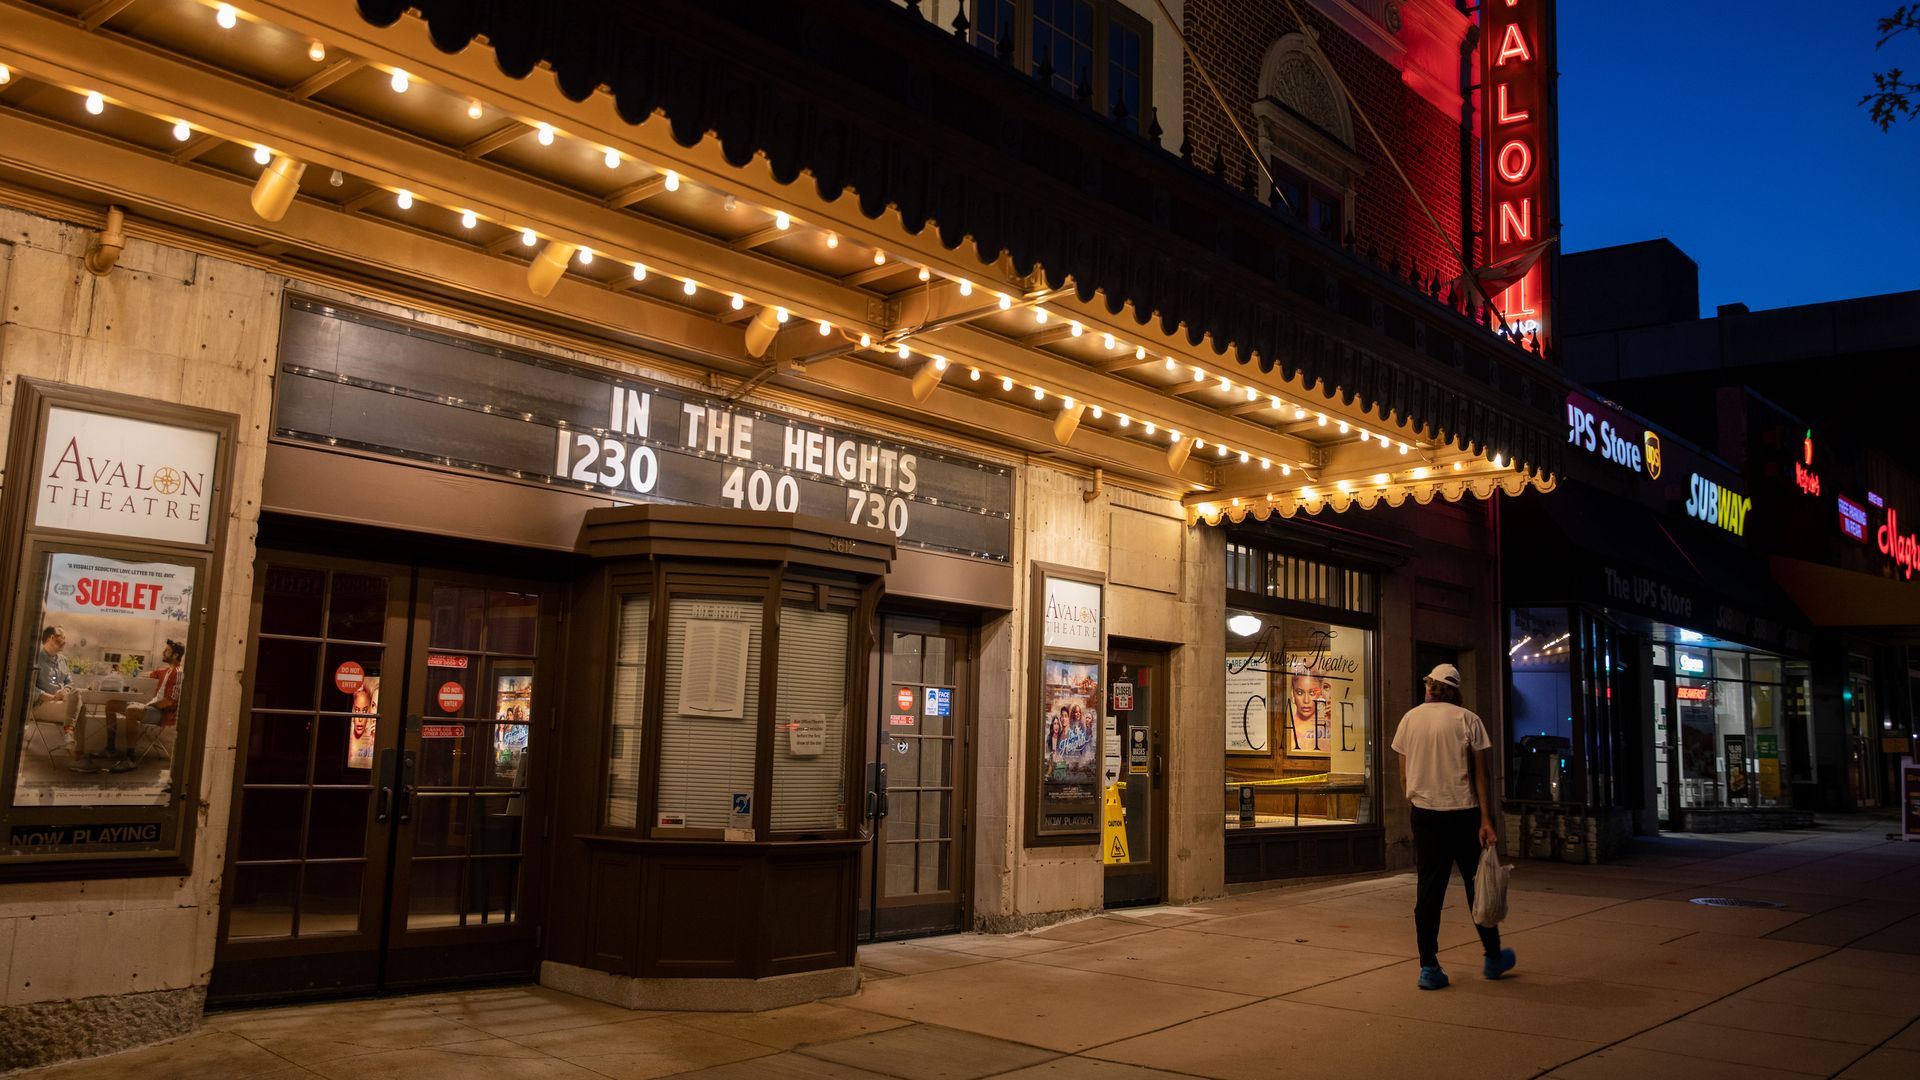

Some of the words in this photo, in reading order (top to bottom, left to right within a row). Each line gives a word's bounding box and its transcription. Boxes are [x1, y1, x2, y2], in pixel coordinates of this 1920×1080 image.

[1496, 0, 1531, 244] ALON
[611, 386, 650, 437] IN
[683, 403, 753, 459] THE
[783, 426, 917, 493] HEIGHTS
[1601, 420, 1641, 472] Store
[1646, 444, 1660, 473] ups
[47, 484, 201, 521] THEATRE
[556, 429, 658, 493] 1230
[722, 466, 799, 513] 400
[849, 489, 908, 537] 730
[1686, 472, 1752, 536] SUBWAY
[75, 577, 163, 611] SUBLET
[1604, 567, 1630, 600] The
[1633, 575, 1657, 608] UPS
[1660, 583, 1693, 617] Store
[1046, 621, 1097, 638] THEATRE
[1304, 630, 1359, 674] Theatre
[1243, 687, 1356, 752] CAFÉ
[10, 830, 65, 846] NOW
[73, 824, 157, 846] PLAYING
[1045, 816, 1062, 825] NOW
[1064, 815, 1094, 825] PLAYING
